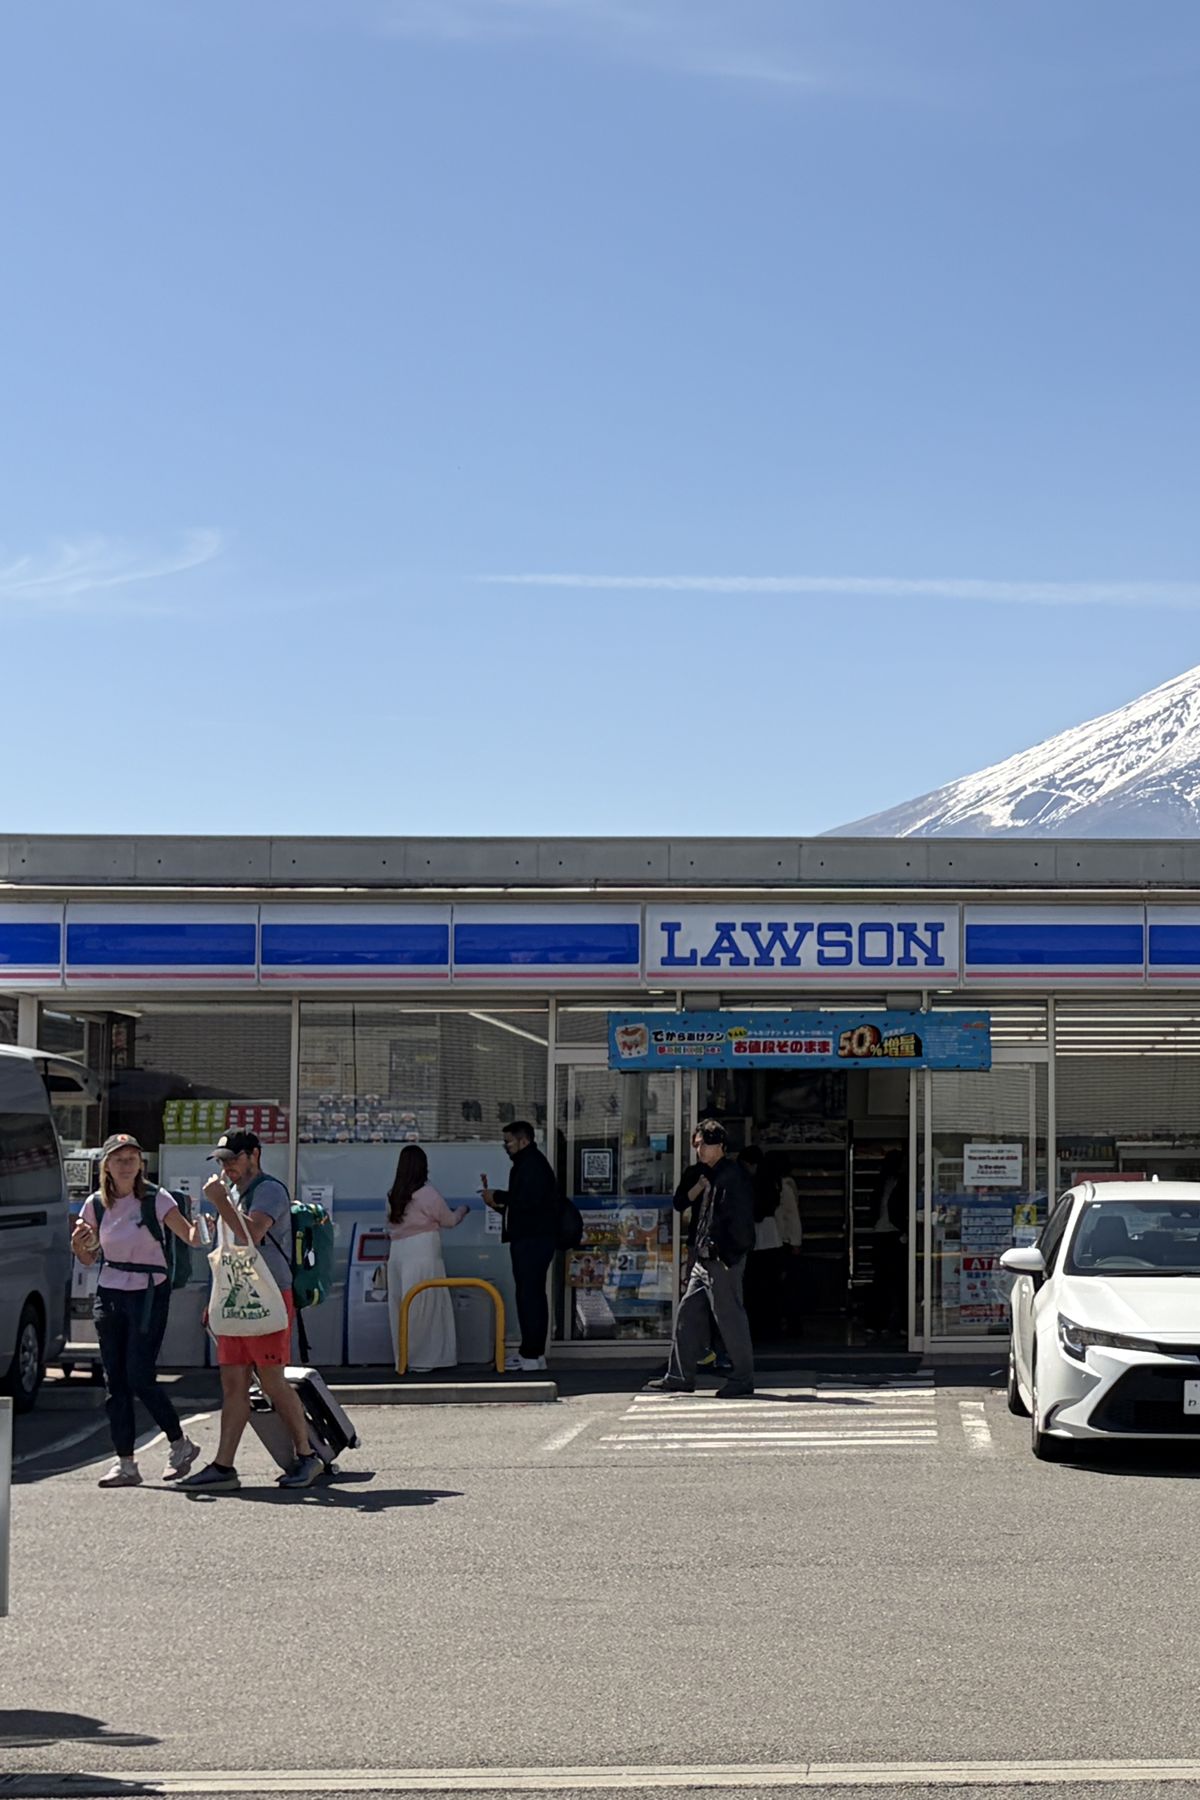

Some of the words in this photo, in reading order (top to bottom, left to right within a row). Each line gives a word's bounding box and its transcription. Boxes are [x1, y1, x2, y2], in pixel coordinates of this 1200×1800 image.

[660, 921, 946, 967] LAWSON
[734, 1040, 831, 1054] お値段そのまま
[1188, 1399, 1197, 1407] わ
